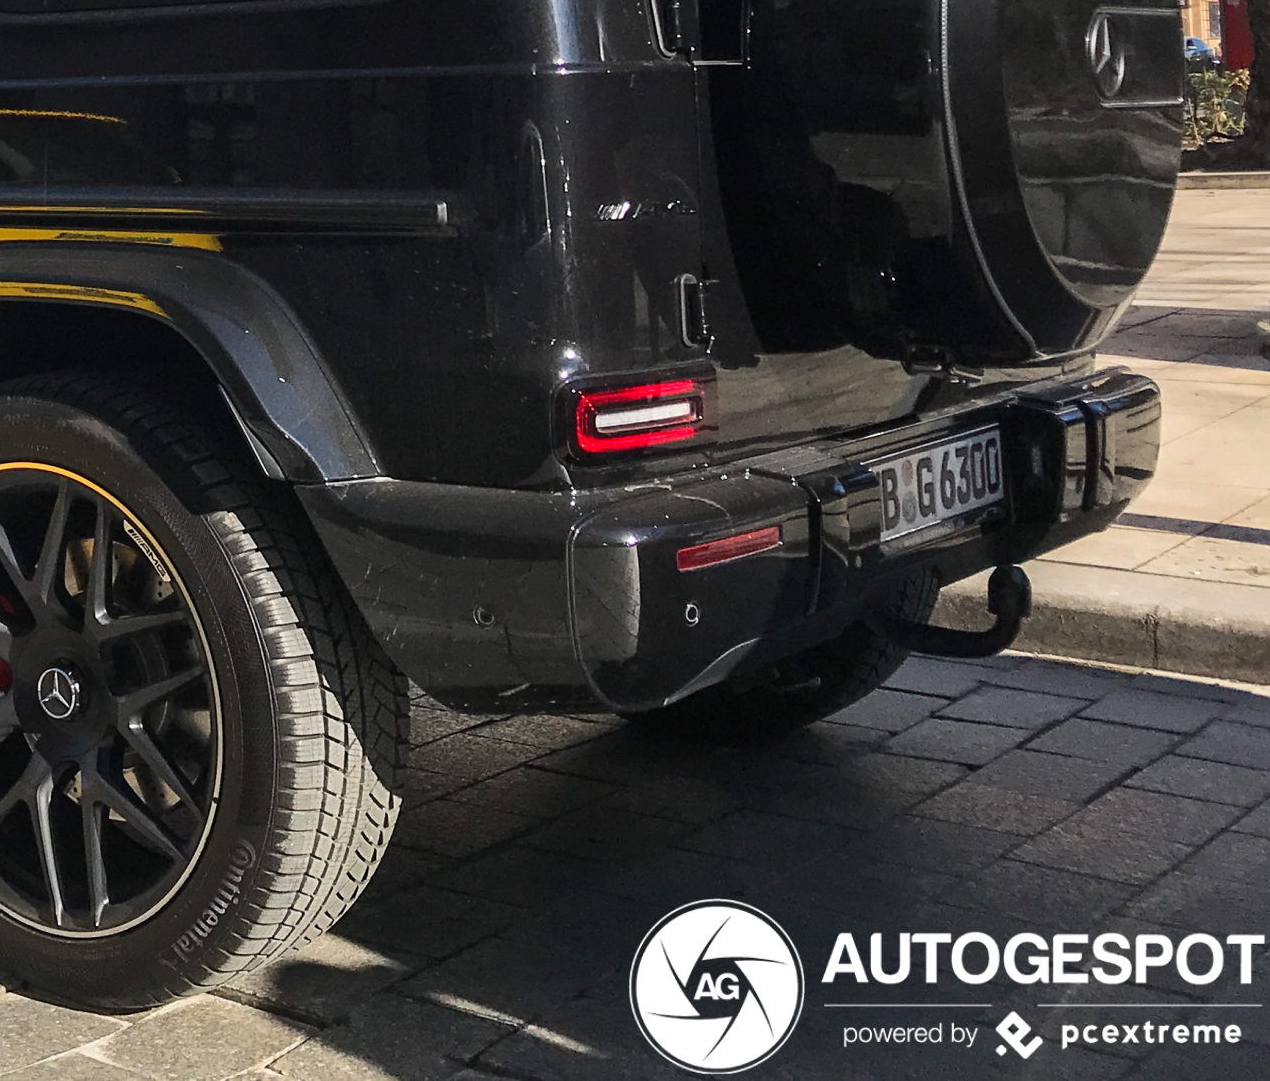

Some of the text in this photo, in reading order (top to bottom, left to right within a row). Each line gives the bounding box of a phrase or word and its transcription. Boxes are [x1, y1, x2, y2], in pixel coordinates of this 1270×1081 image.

[882, 468, 901, 531] B
[138, 540, 167, 577] AMG
[171, 838, 256, 963] Continental
